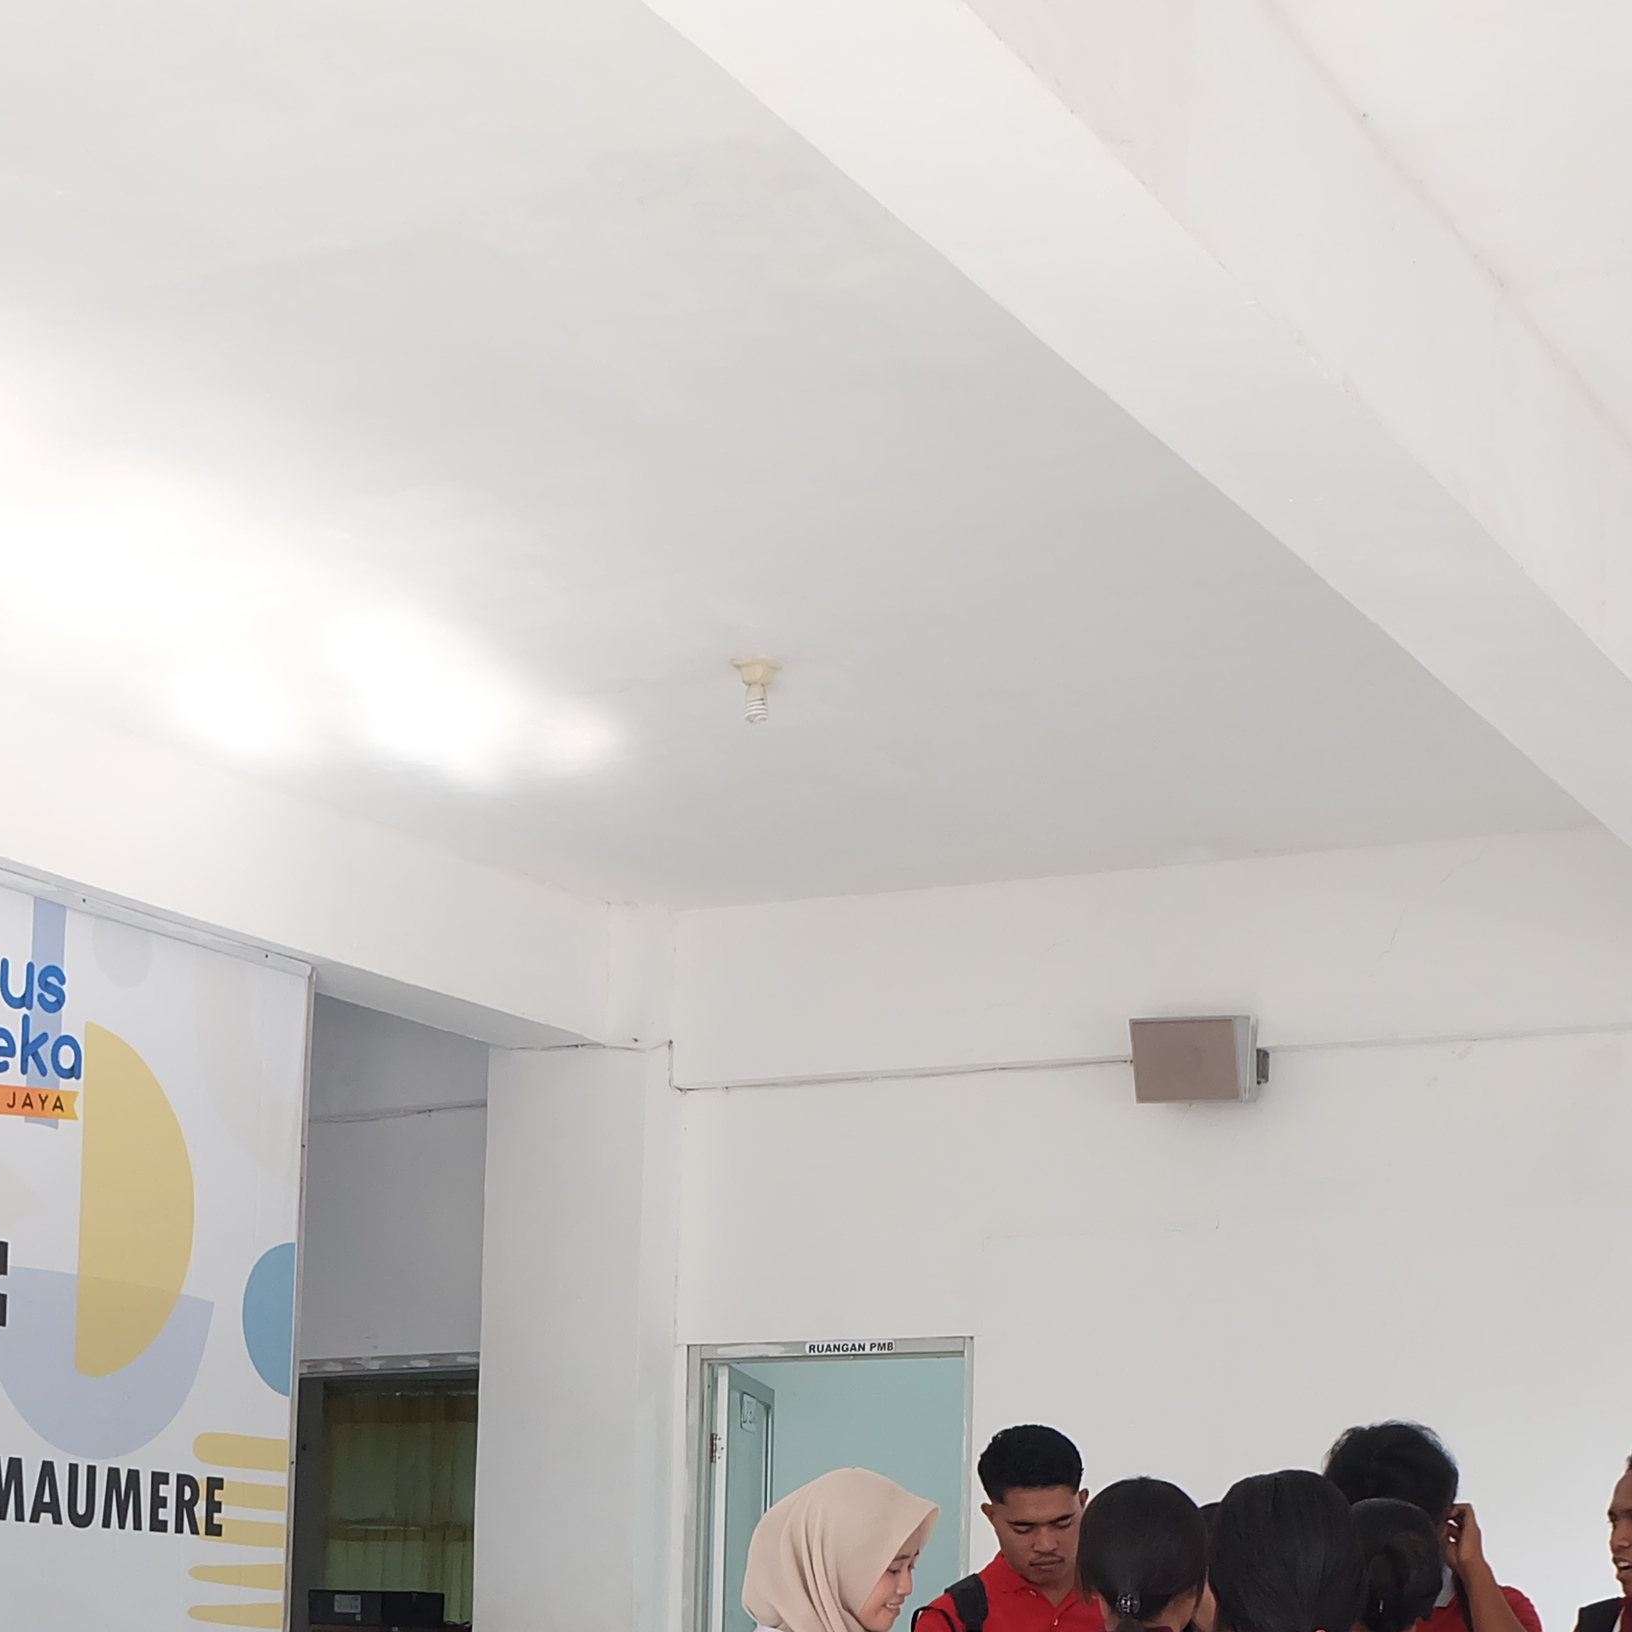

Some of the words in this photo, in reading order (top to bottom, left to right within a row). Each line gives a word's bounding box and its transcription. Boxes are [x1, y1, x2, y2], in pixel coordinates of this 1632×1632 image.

[6, 1091, 66, 1114] JAYA
[808, 1342, 867, 1354] RUANGAN
[869, 1341, 894, 1353] PMB
